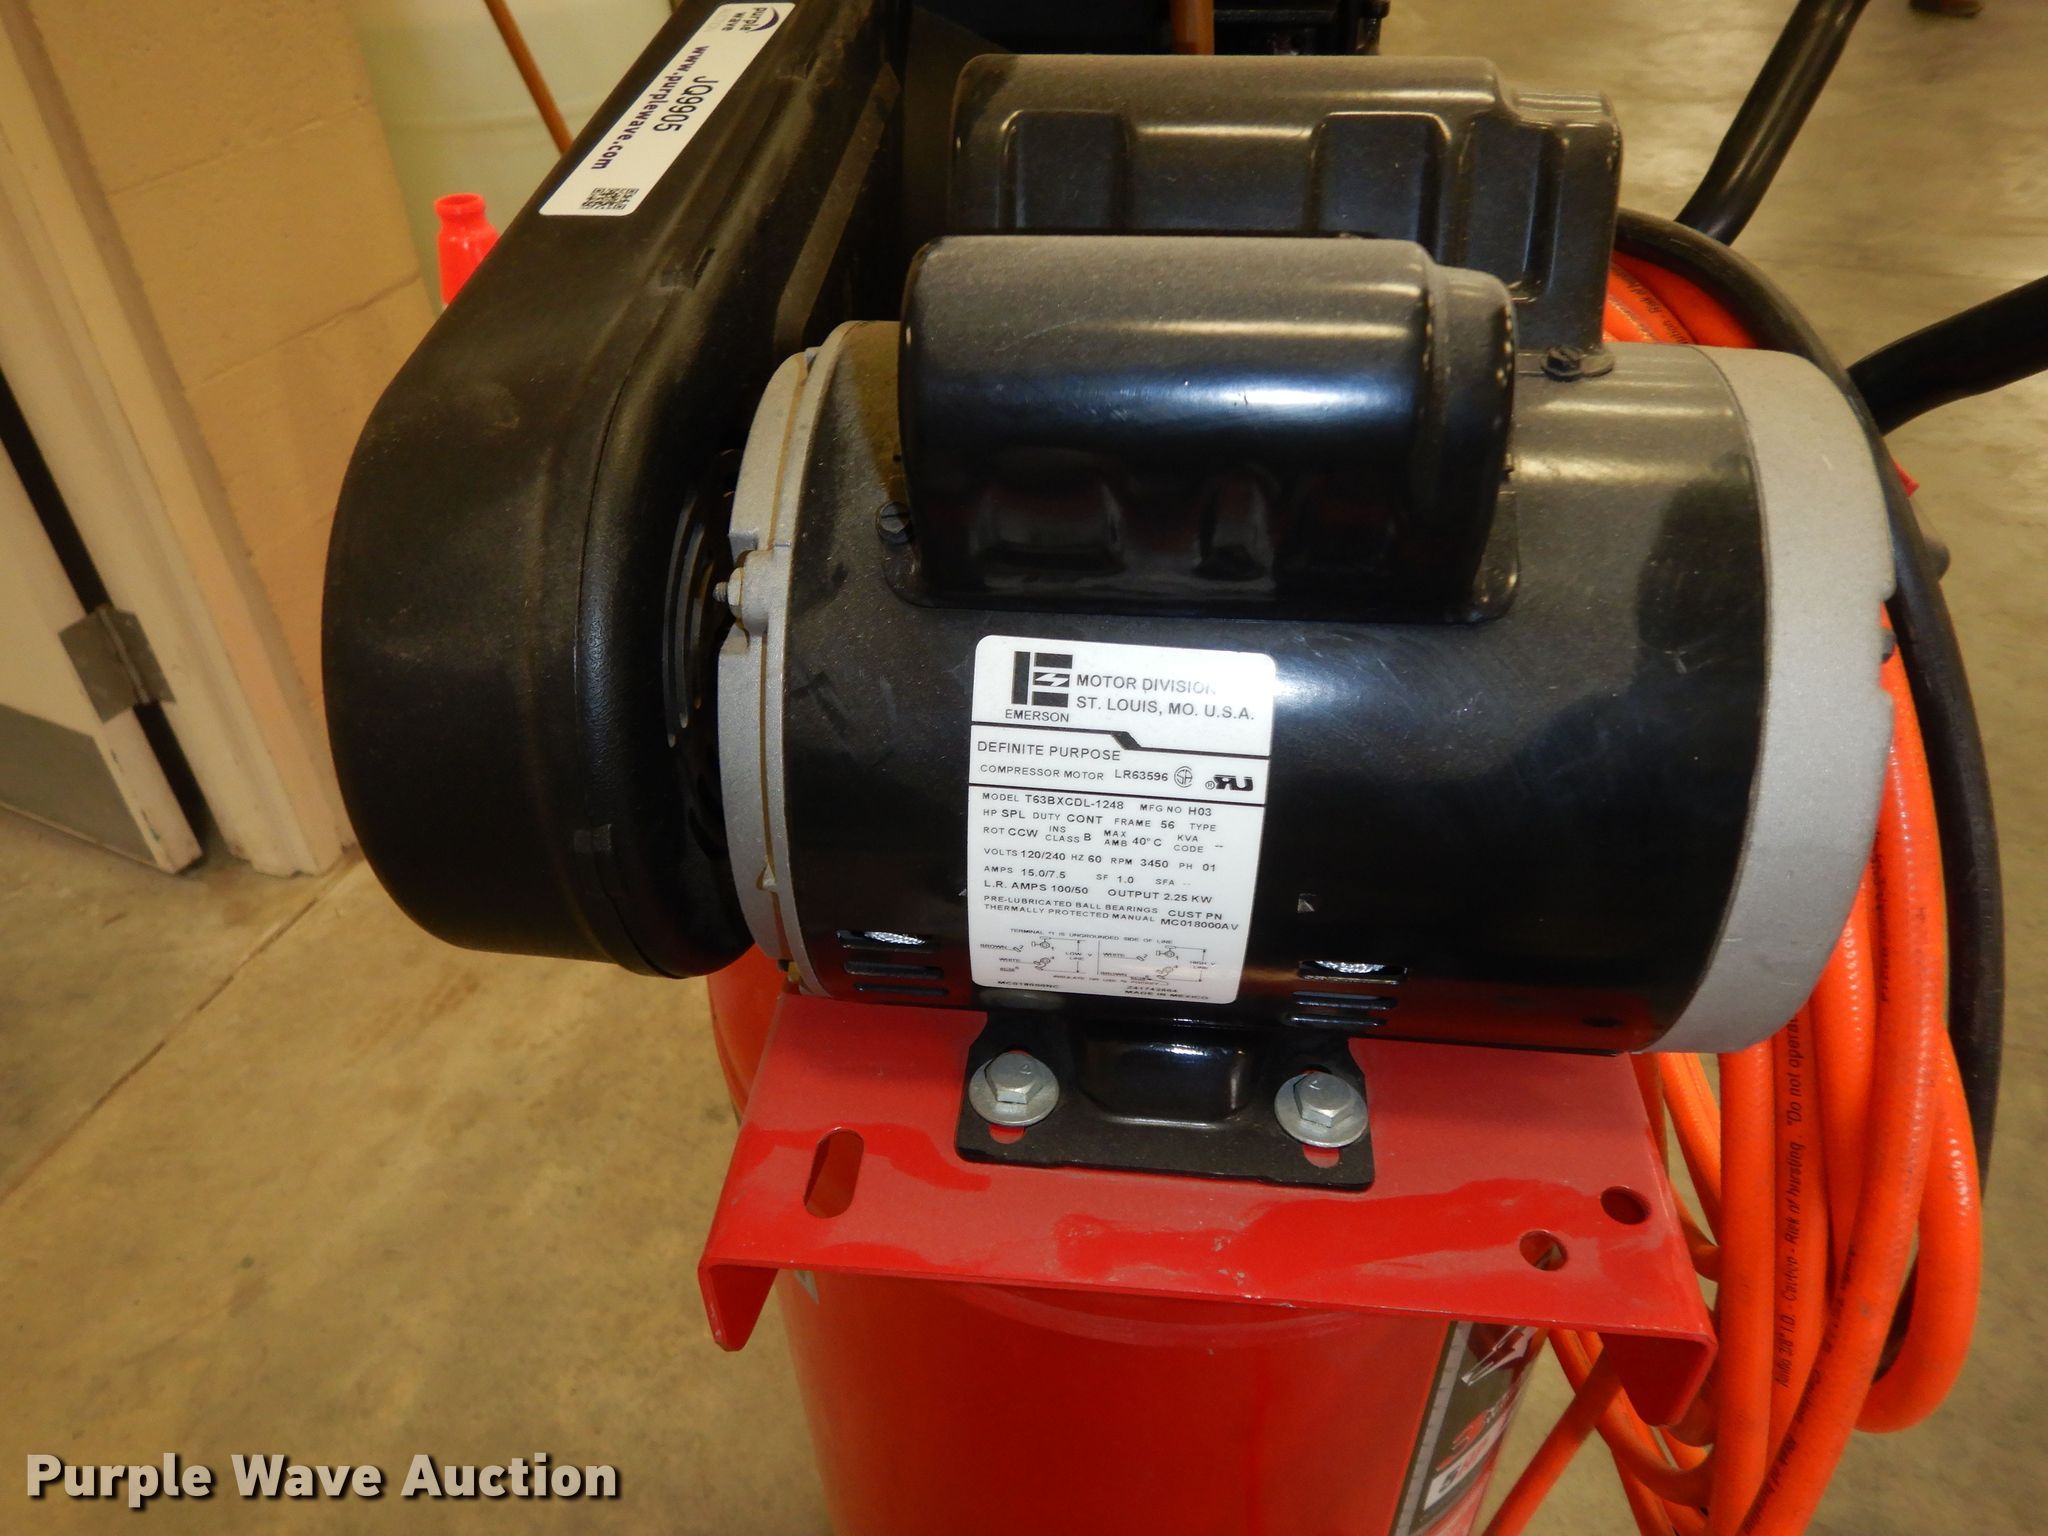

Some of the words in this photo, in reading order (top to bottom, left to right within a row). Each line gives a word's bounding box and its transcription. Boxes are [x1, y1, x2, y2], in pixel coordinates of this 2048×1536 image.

[591, 45, 710, 170] www.purplewave.com
[652, 75, 719, 132] JQ9905
[1076, 674, 1137, 690] MOTOR
[1005, 708, 1070, 723] EMERSON
[1076, 696, 1101, 710] ST.
[1107, 698, 1163, 716] LOUIS,
[1168, 702, 1198, 717] MO.
[1204, 704, 1255, 720] U.S.A.
[977, 741, 1044, 756] DEFINITE
[1049, 746, 1121, 761] PURPOSE
[980, 764, 1060, 777] COMPRESSOR
[1063, 770, 1104, 781] MOTOR
[1114, 768, 1169, 783] LR63596
[982, 792, 1019, 802] MODEL
[1025, 794, 1124, 810] T63BXCDL-1248
[1140, 804, 1163, 812] MFG
[1167, 805, 1182, 814] NO
[1188, 806, 1212, 817] H03
[1001, 809, 1026, 819] SPL
[1032, 812, 1060, 821] DUTY
[1066, 814, 1103, 824] CONT
[1114, 818, 1151, 828] FRAME
[1160, 820, 1175, 830] 56
[1190, 822, 1217, 832] TYPE
[1049, 825, 1066, 833] INS
[983, 827, 1005, 835] ROT
[1008, 828, 1038, 838] CCW
[1045, 835, 1080, 843] CLASS
[1083, 833, 1092, 842] B
[1103, 830, 1127, 838] MAX
[1177, 834, 1199, 842] KVA
[1104, 839, 1128, 847] AMB
[1173, 845, 1204, 853] CODE
[984, 848, 1018, 856] VOLTS
[1021, 850, 1066, 861] 120/240
[1087, 855, 1102, 863] 60
[1110, 857, 1133, 865] RPM
[1140, 859, 1169, 869] 3450
[1179, 862, 1193, 870] PH
[1202, 863, 1216, 872] 01
[984, 866, 1014, 874] AMPS
[1021, 868, 1066, 879] 15.0/7.5
[1117, 876, 1134, 884] 1.0
[1155, 878, 1175, 886] SFA
[984, 880, 1007, 889] L.R.
[1011, 882, 1047, 892] AMPS
[1051, 885, 1088, 894] 100/50
[1108, 889, 1159, 899] OUTPUT
[1163, 893, 1188, 902] 2.25
[1191, 895, 1212, 904] KW
[984, 895, 1072, 908] PRE-LUBRICATED
[1075, 902, 1101, 910] BALL
[1105, 904, 1158, 914] BEARINGS
[984, 904, 1044, 914] THERMALLY
[1048, 909, 1109, 919] PROTECTED
[1112, 914, 1155, 922] MANUAL
[1168, 910, 1202, 919] CUST
[1206, 912, 1222, 921] PN
[1786, 1072, 1802, 1097] not
